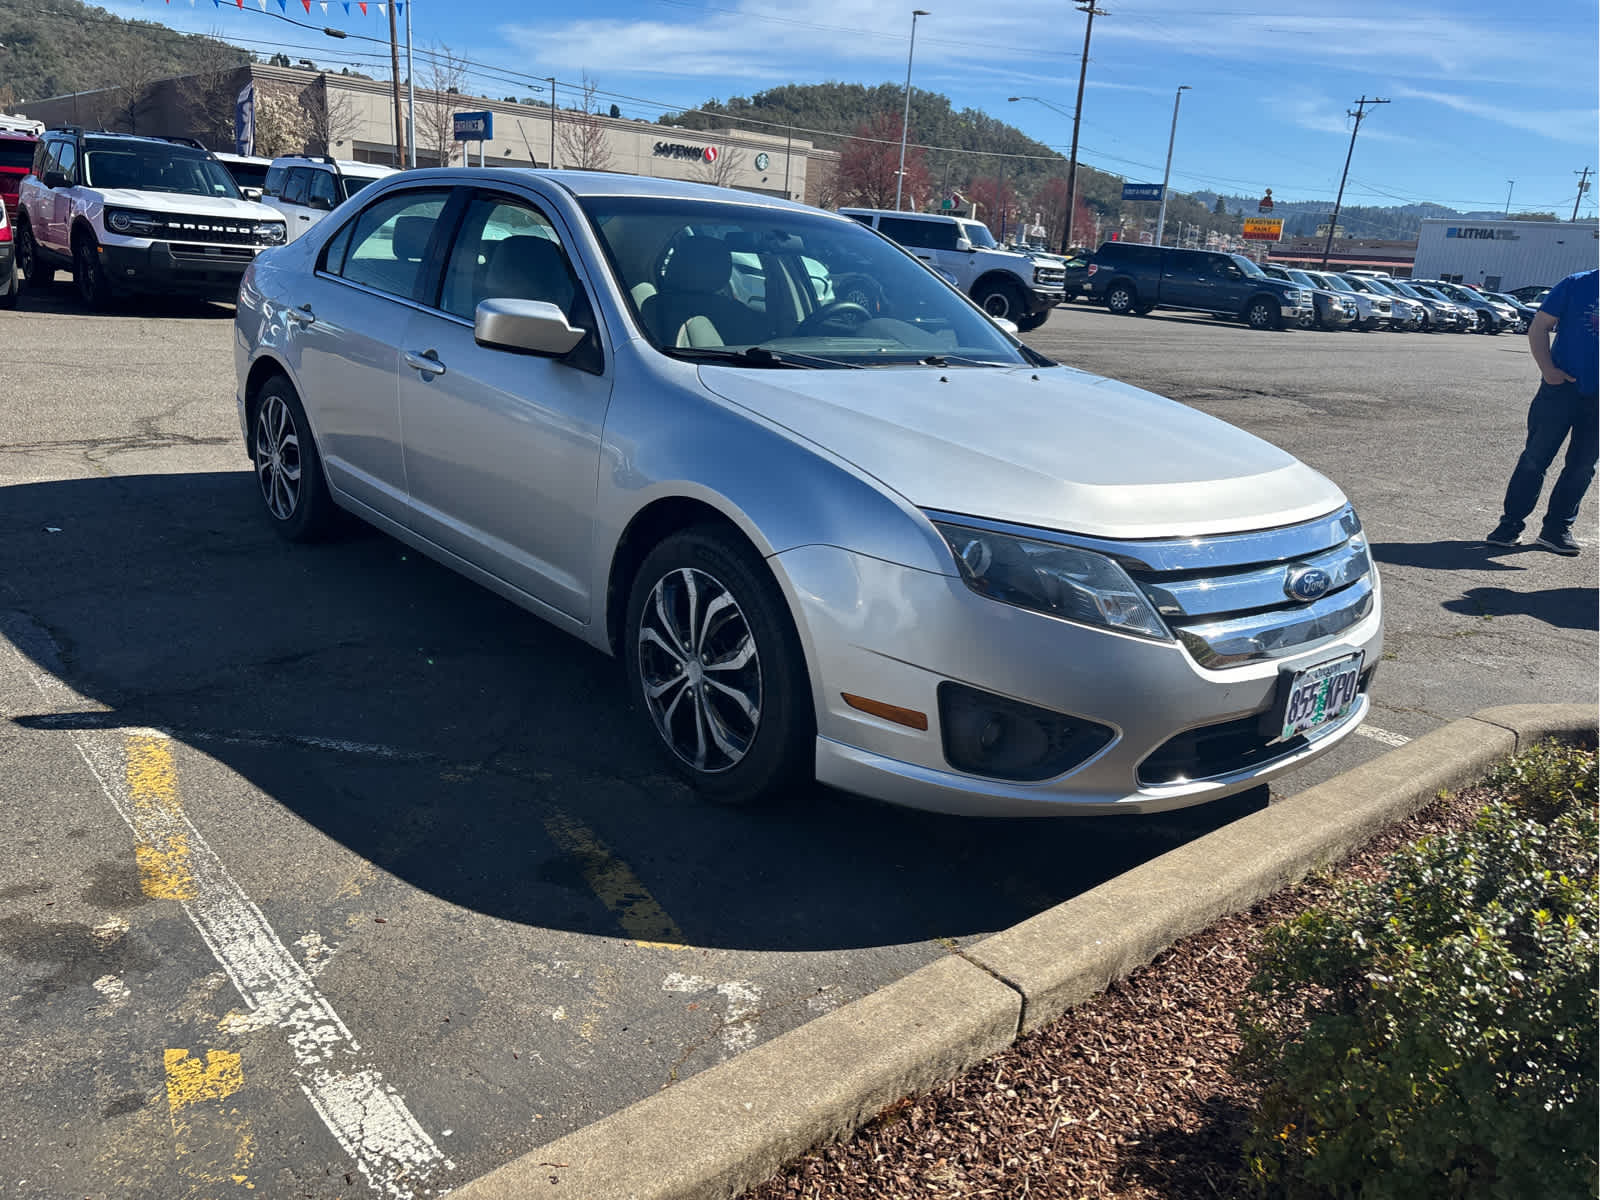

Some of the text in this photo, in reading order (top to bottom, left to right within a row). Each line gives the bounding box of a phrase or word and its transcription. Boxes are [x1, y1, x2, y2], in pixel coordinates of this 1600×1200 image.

[653, 141, 704, 161] SAFEWAY
[168, 222, 251, 234] BRONCO
[1456, 227, 1494, 240] LITHIA
[1303, 573, 1325, 593] Ford
[1287, 681, 1321, 726] 855
